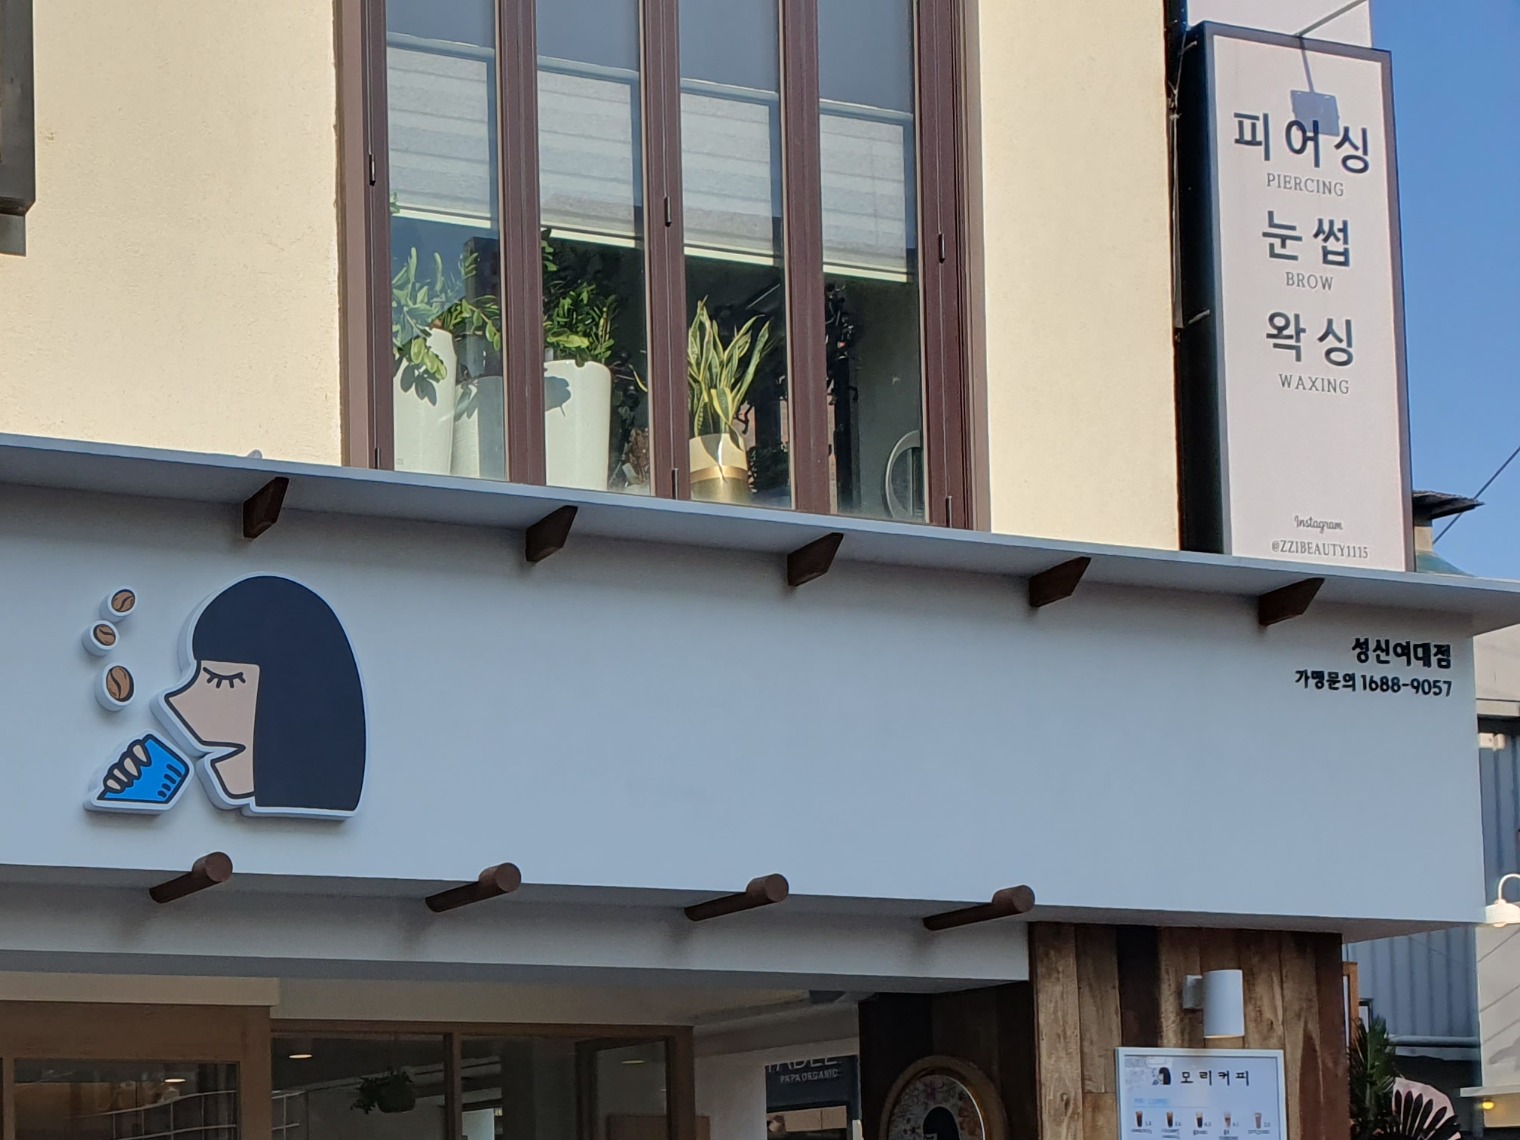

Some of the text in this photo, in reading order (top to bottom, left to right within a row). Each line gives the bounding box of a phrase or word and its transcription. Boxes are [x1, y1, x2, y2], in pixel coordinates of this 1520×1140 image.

[1232, 111, 1371, 174] 피어싱
[1266, 172, 1344, 197] PIERCING
[1262, 210, 1350, 268] 눈썹
[1285, 271, 1333, 291] BROW
[1265, 311, 1354, 367] 왁싱
[1278, 373, 1349, 395] WAXING
[1294, 515, 1343, 534] Instagram
[1351, 637, 1451, 669] 성신여대점
[1295, 669, 1452, 697] 가맹문의 1688-9057
[1181, 1070, 1249, 1086] 모리커피
